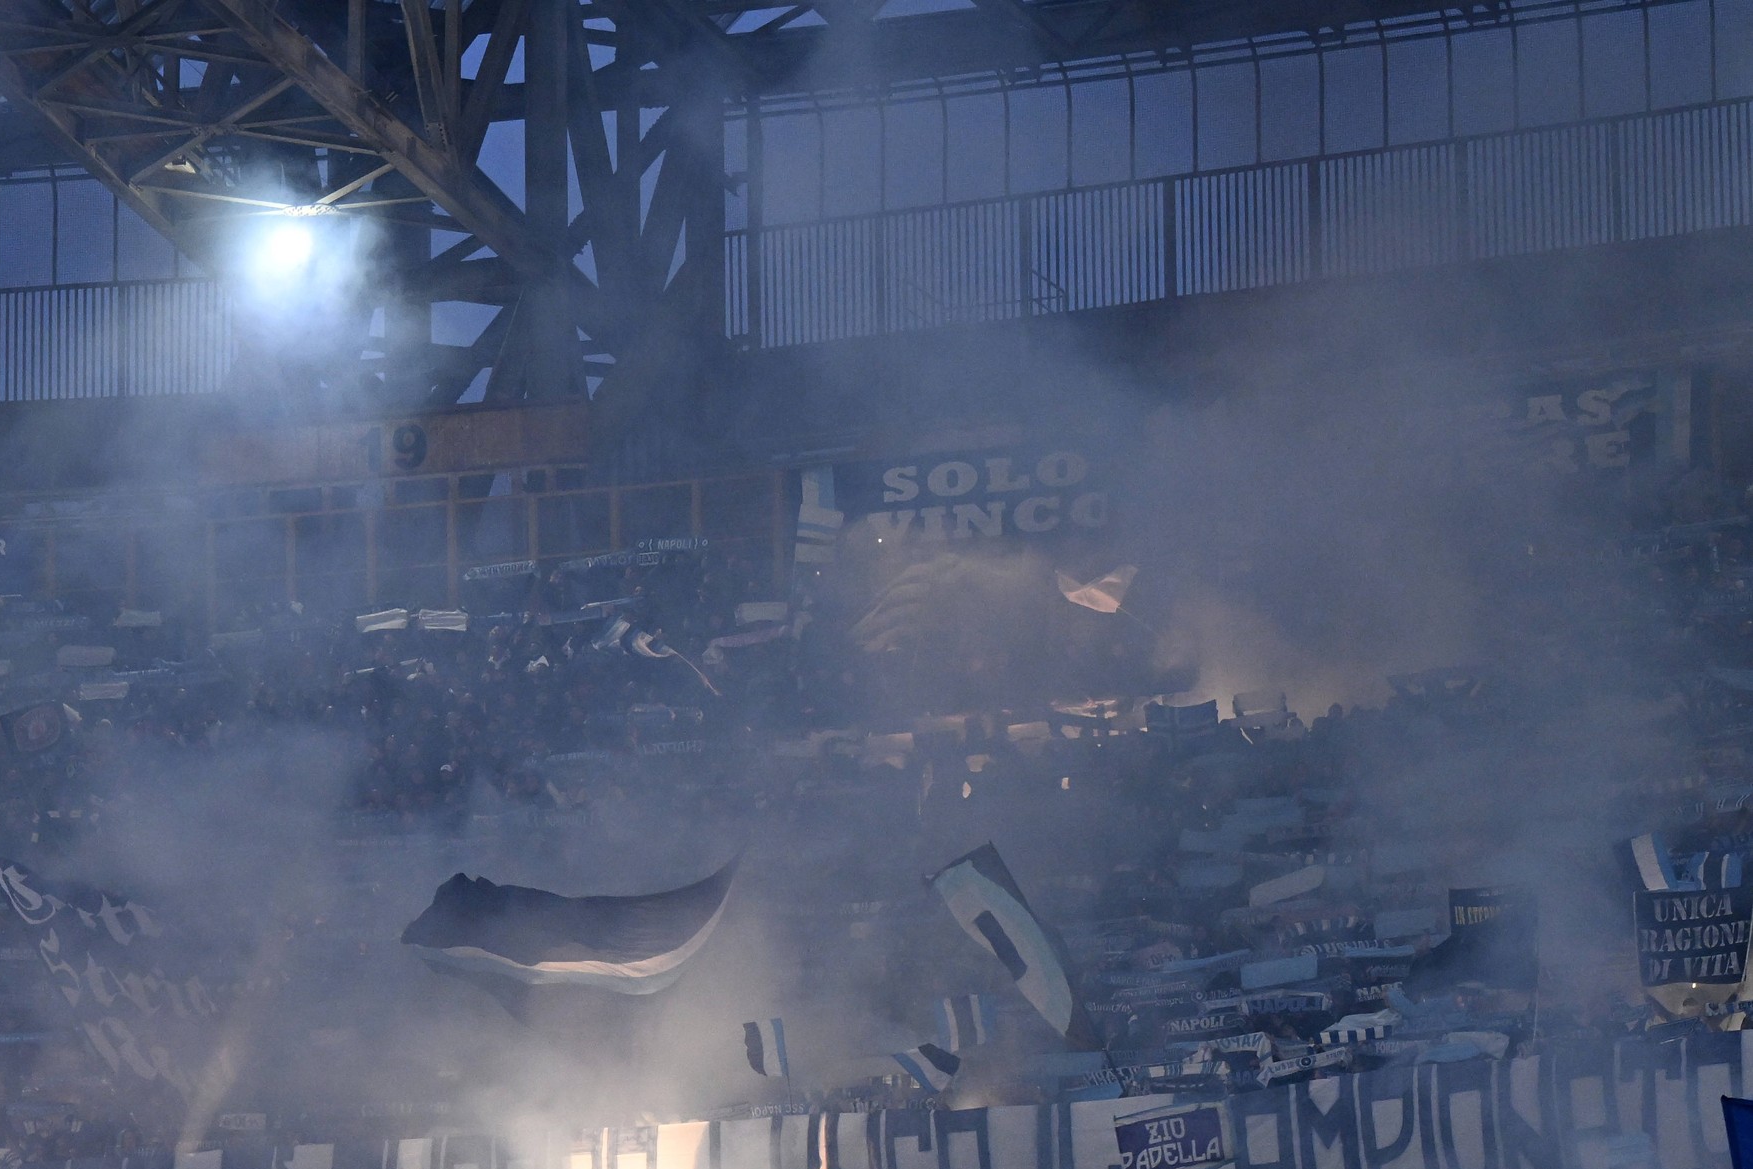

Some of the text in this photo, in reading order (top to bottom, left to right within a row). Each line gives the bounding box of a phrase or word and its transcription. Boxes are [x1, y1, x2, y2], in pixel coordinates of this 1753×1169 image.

[361, 423, 427, 468] 19
[882, 451, 1089, 503] SOLO
[1654, 893, 1732, 921] UNICA
[1684, 951, 1740, 977] VITA
[1170, 1016, 1225, 1032] NAPOLI
[1147, 1118, 1185, 1141] ZIO
[1122, 1139, 1221, 1169] PADELLA
